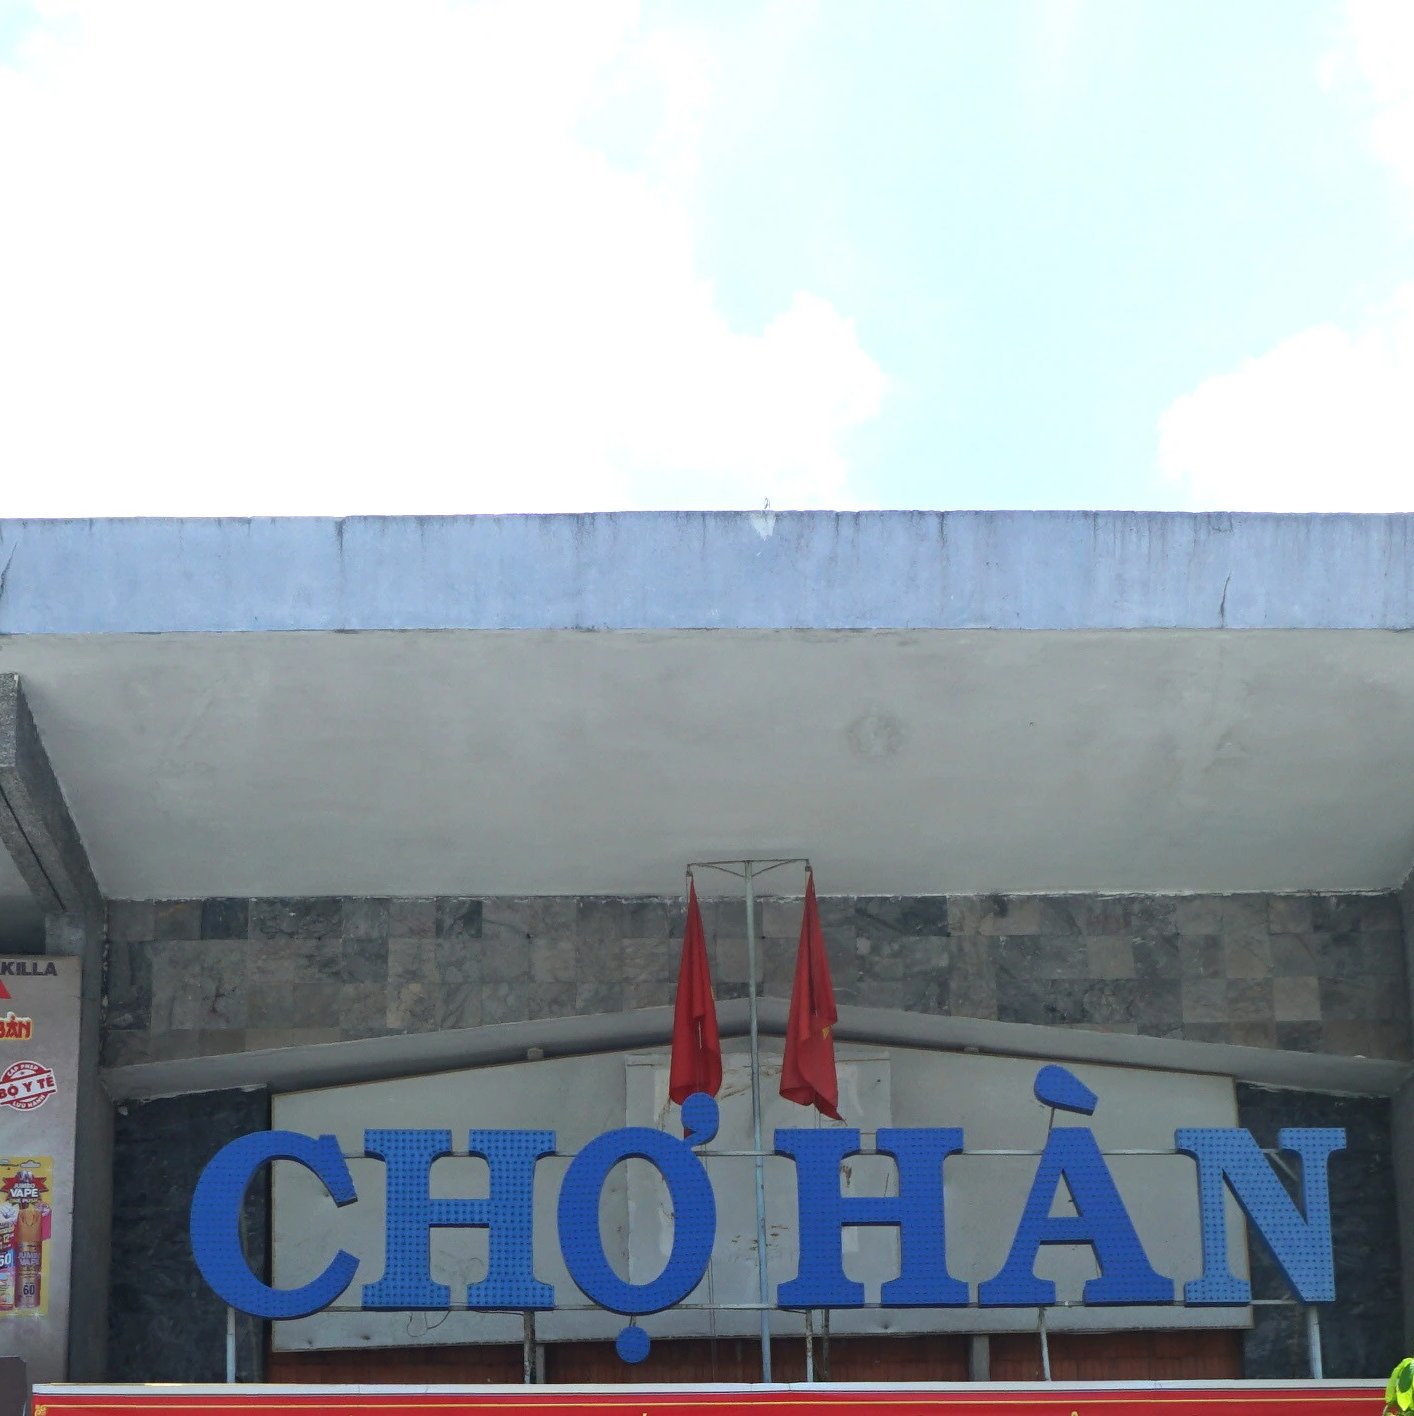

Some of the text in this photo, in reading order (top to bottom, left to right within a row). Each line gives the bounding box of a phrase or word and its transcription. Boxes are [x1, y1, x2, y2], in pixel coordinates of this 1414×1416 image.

[22, 1081, 32, 1092] Y
[36, 1075, 55, 1089] TẾ
[9, 1189, 39, 1198] VAPE
[190, 1064, 1346, 1364] CHỢ HÀN
